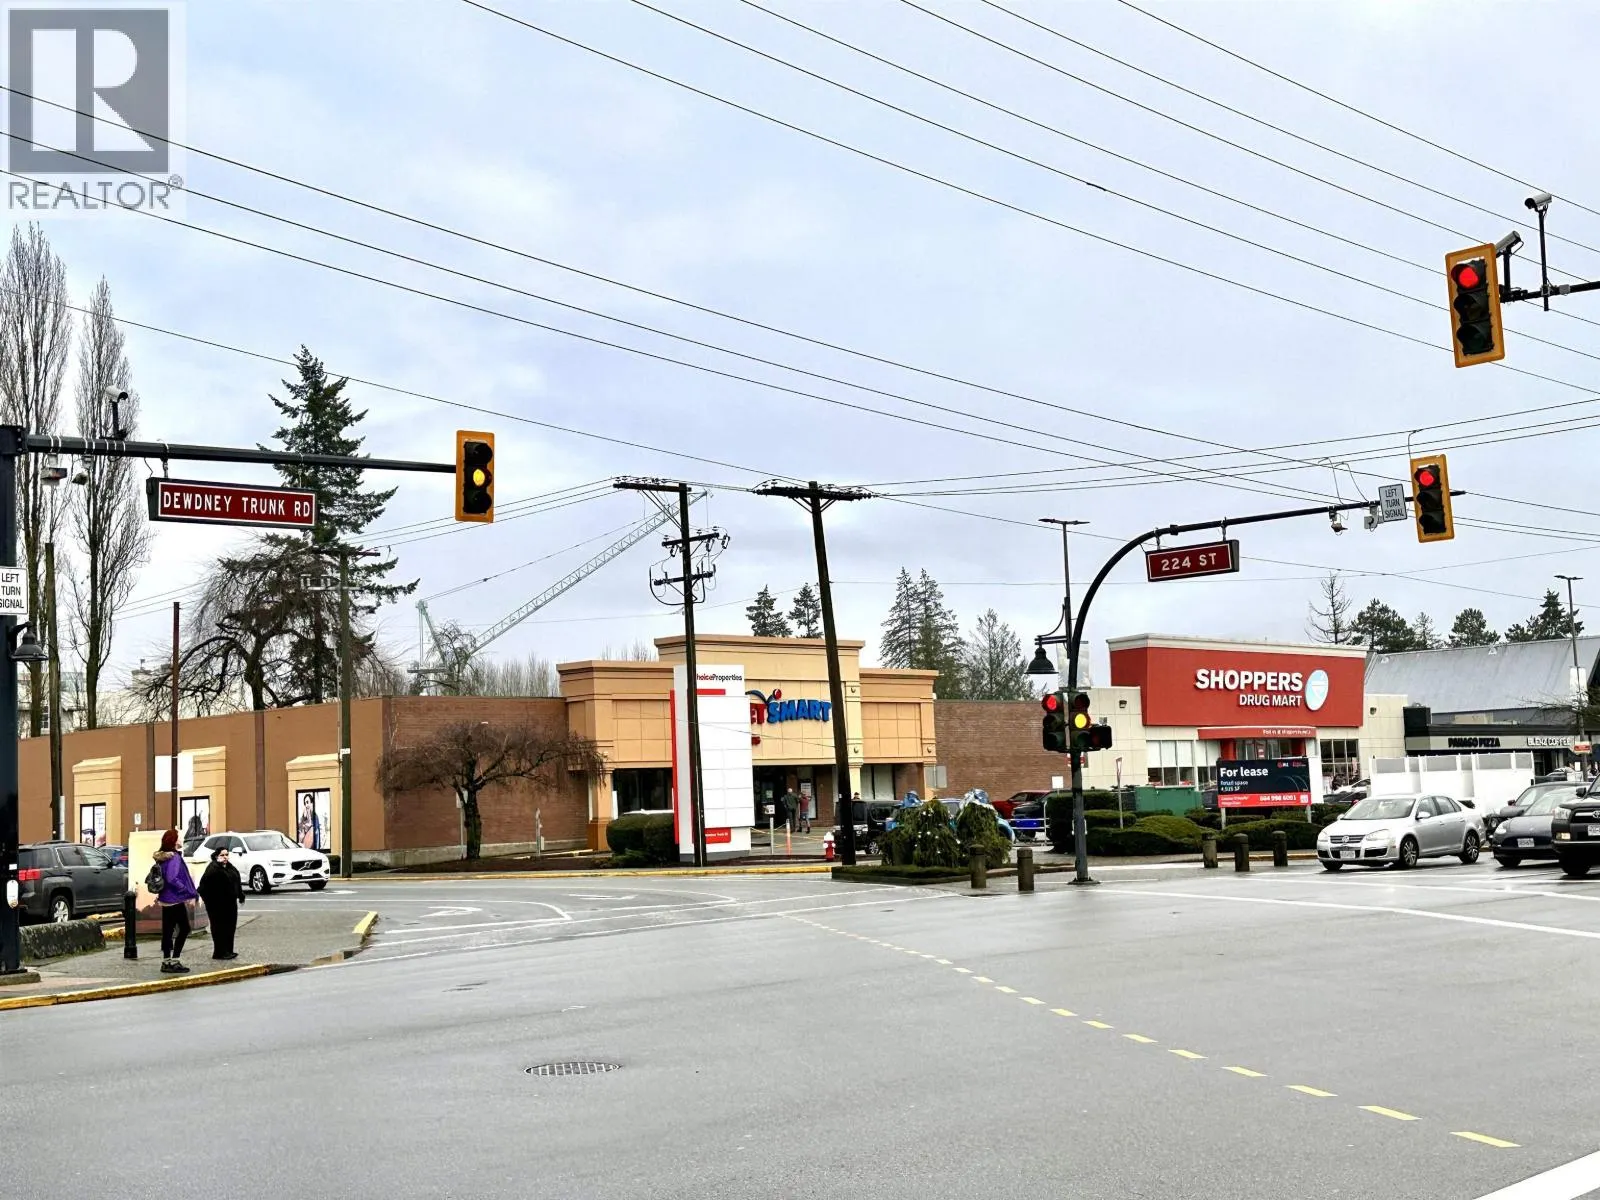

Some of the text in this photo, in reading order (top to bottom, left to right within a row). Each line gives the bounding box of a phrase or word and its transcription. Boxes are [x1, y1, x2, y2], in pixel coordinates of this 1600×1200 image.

[1385, 488, 1397, 498] LEFT
[163, 491, 310, 517] DEWDNEY TRUNK RD
[1385, 498, 1400, 508] TURN
[1385, 508, 1404, 519] SIGNAL
[1161, 553, 1216, 571] 224 ST
[2, 572, 19, 583] LEFT
[1, 585, 21, 596] TURN
[696, 673, 743, 682] hoiceProperties
[1195, 668, 1303, 692] SHOPPERS
[1239, 694, 1302, 706] DRUG MART
[1479, 737, 1501, 748] PIZZA
[1219, 766, 1269, 778] For lease
